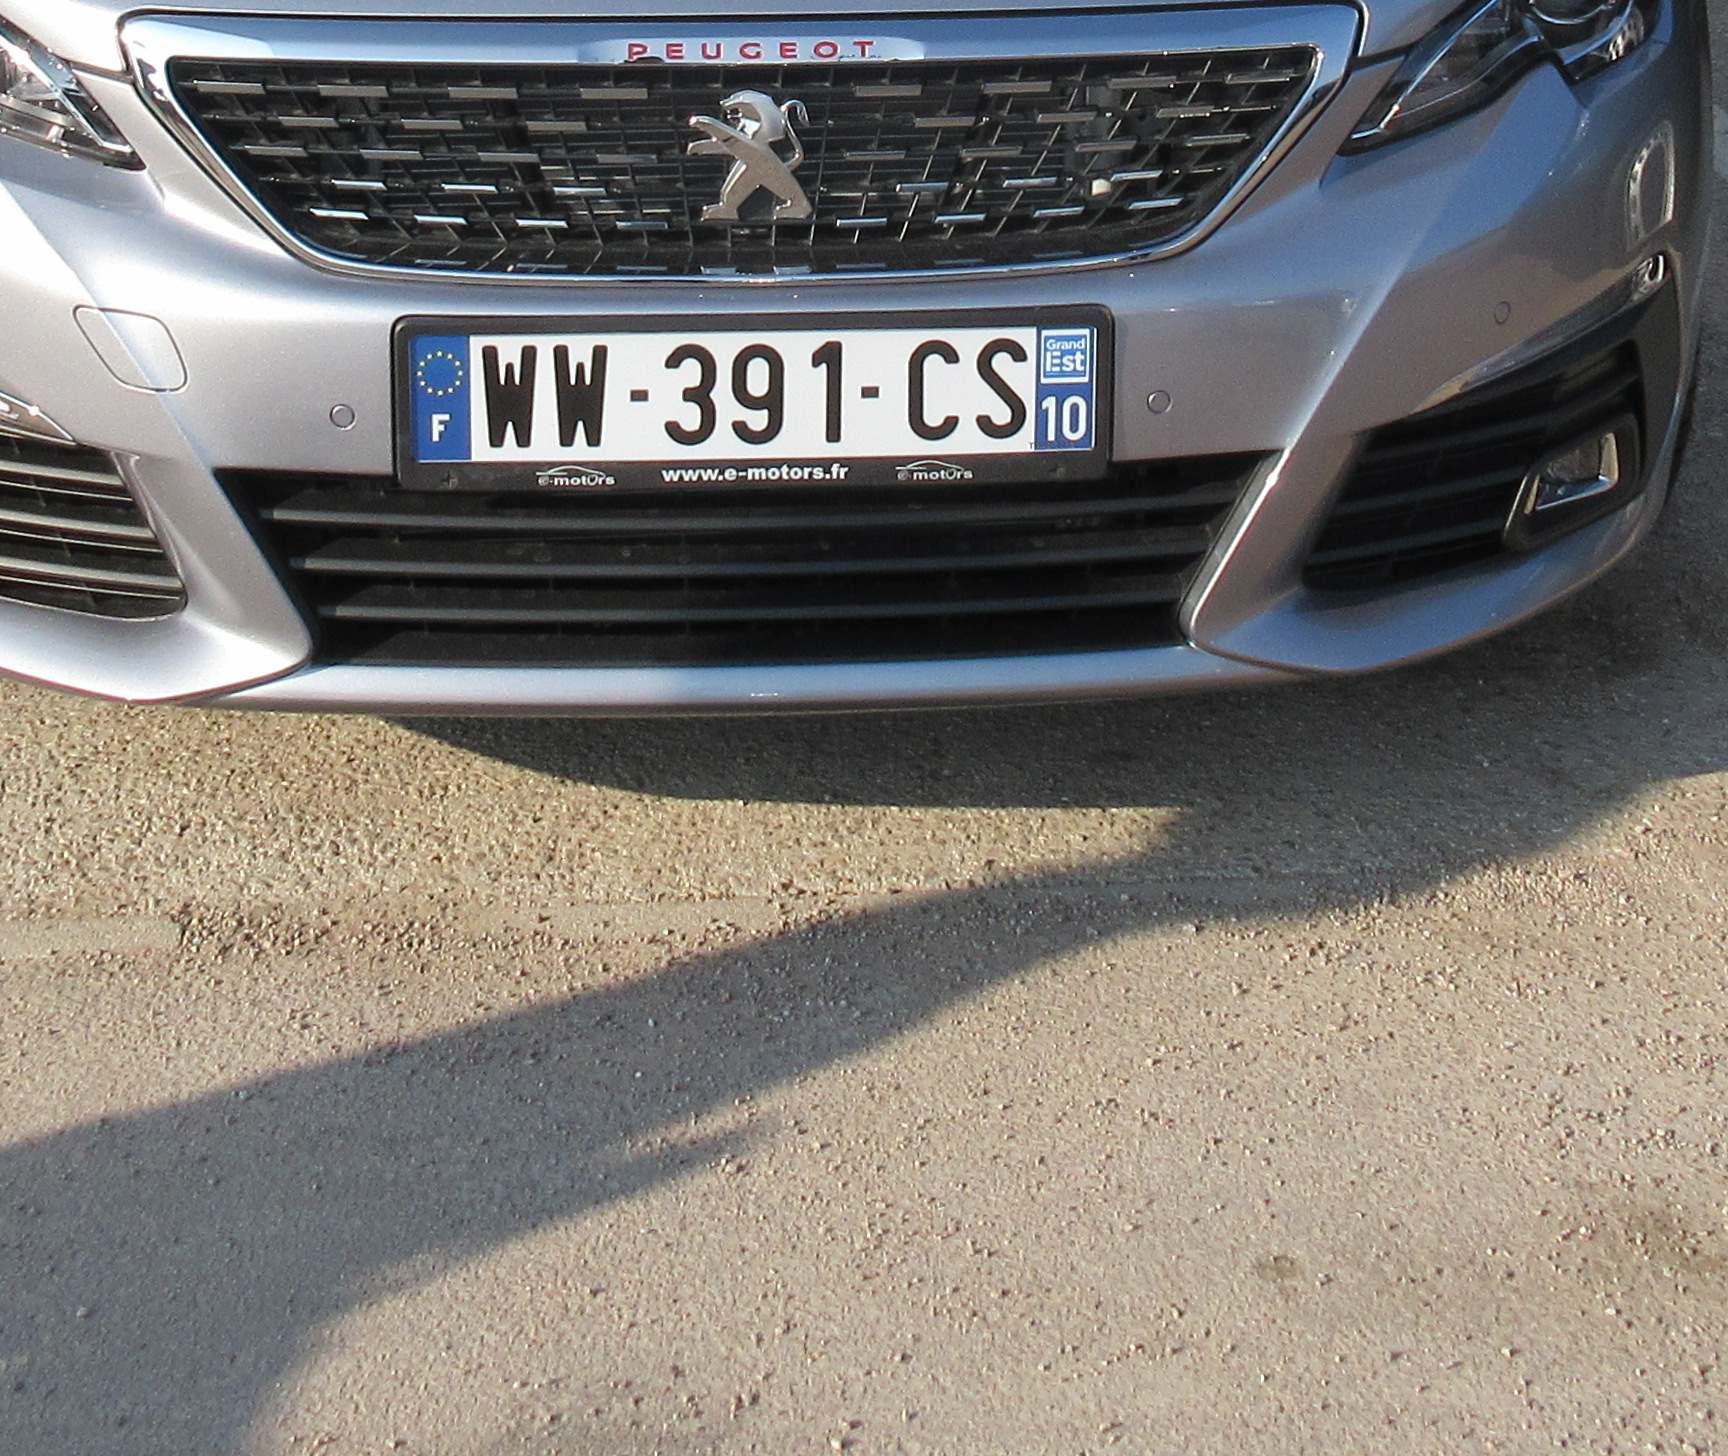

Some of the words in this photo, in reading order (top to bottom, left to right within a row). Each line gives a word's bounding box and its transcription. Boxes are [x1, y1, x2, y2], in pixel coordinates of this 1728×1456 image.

[628, 41, 875, 60] PEUGEOT
[1045, 338, 1086, 350] Grand
[1045, 351, 1085, 372] Est
[482, 338, 1027, 448] WW-391-CS
[430, 413, 452, 443] F
[1041, 395, 1087, 442] 10
[661, 464, 849, 482] www.e-motors.fr
